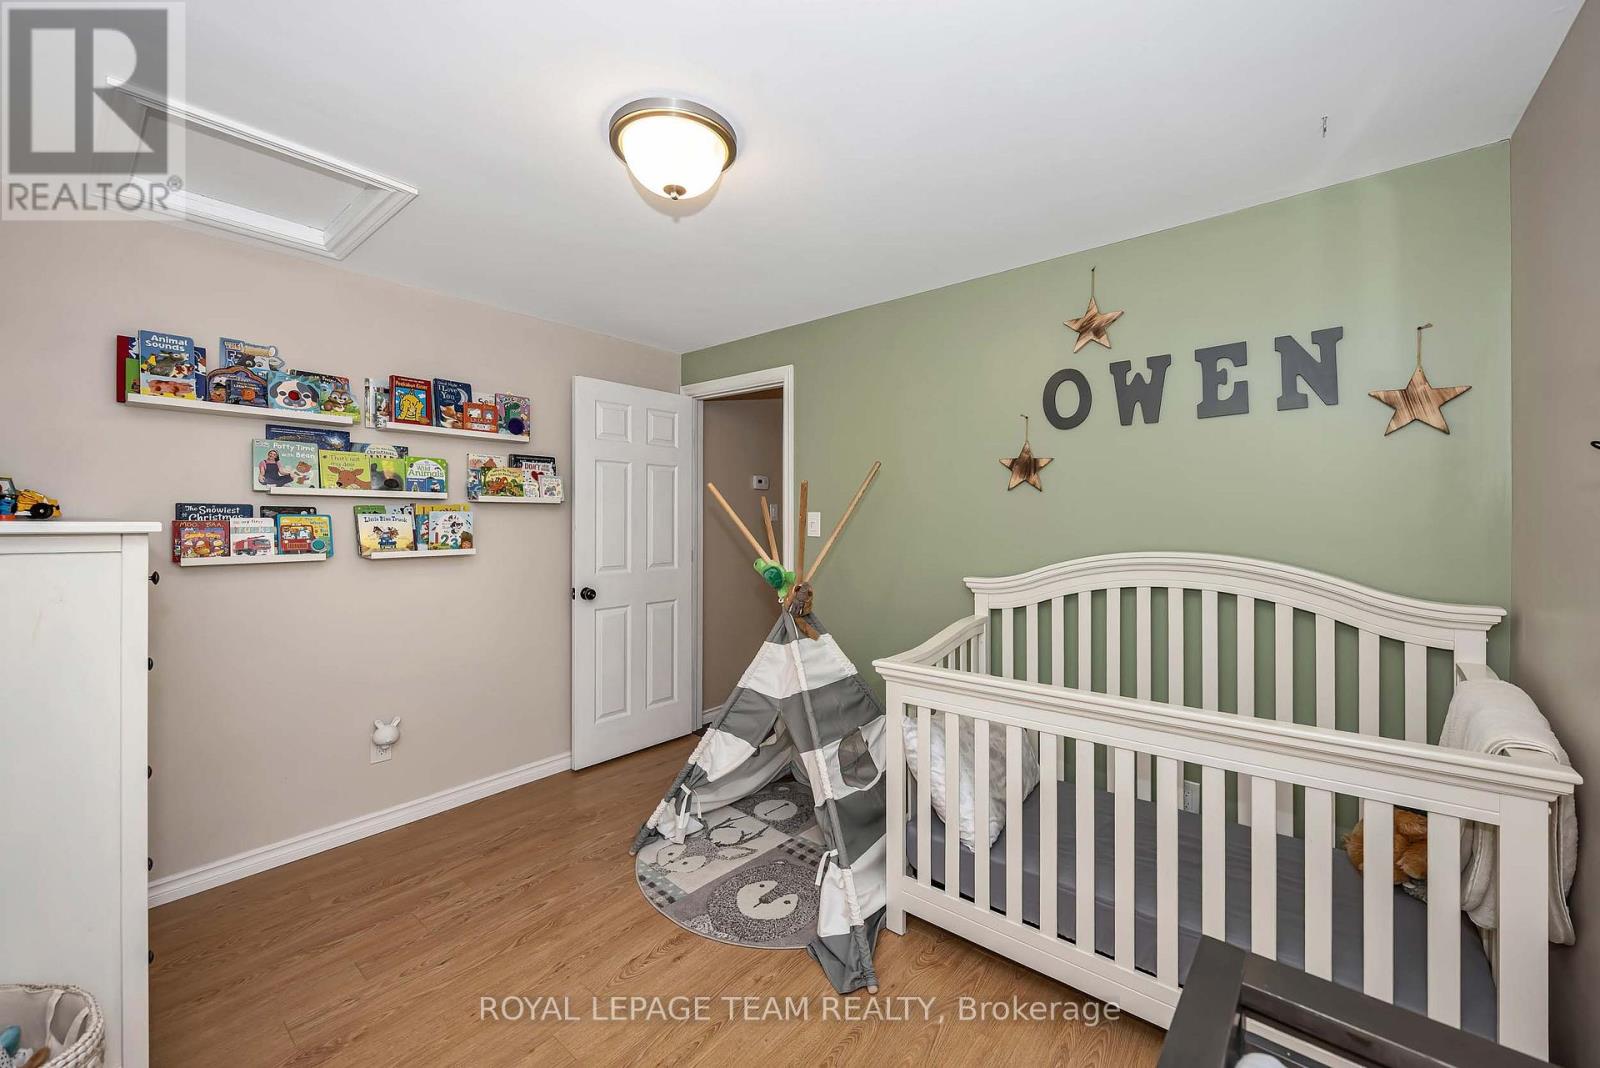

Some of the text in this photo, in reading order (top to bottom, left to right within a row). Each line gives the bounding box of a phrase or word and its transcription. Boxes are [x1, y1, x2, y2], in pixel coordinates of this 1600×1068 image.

[150, 334, 188, 346] Animal
[145, 340, 185, 352] Sounds
[1042, 326, 1344, 430] OWEN
[441, 385, 458, 393] Love
[441, 391, 455, 400] You
[273, 442, 294, 451] Potty
[294, 444, 315, 452] Time
[416, 464, 431, 472] Wild
[408, 469, 445, 478] Animals
[198, 505, 240, 515] Snowiest
[391, 515, 408, 523] Truck
[440, 534, 450, 546] 2
[450, 537, 460, 549] 3
